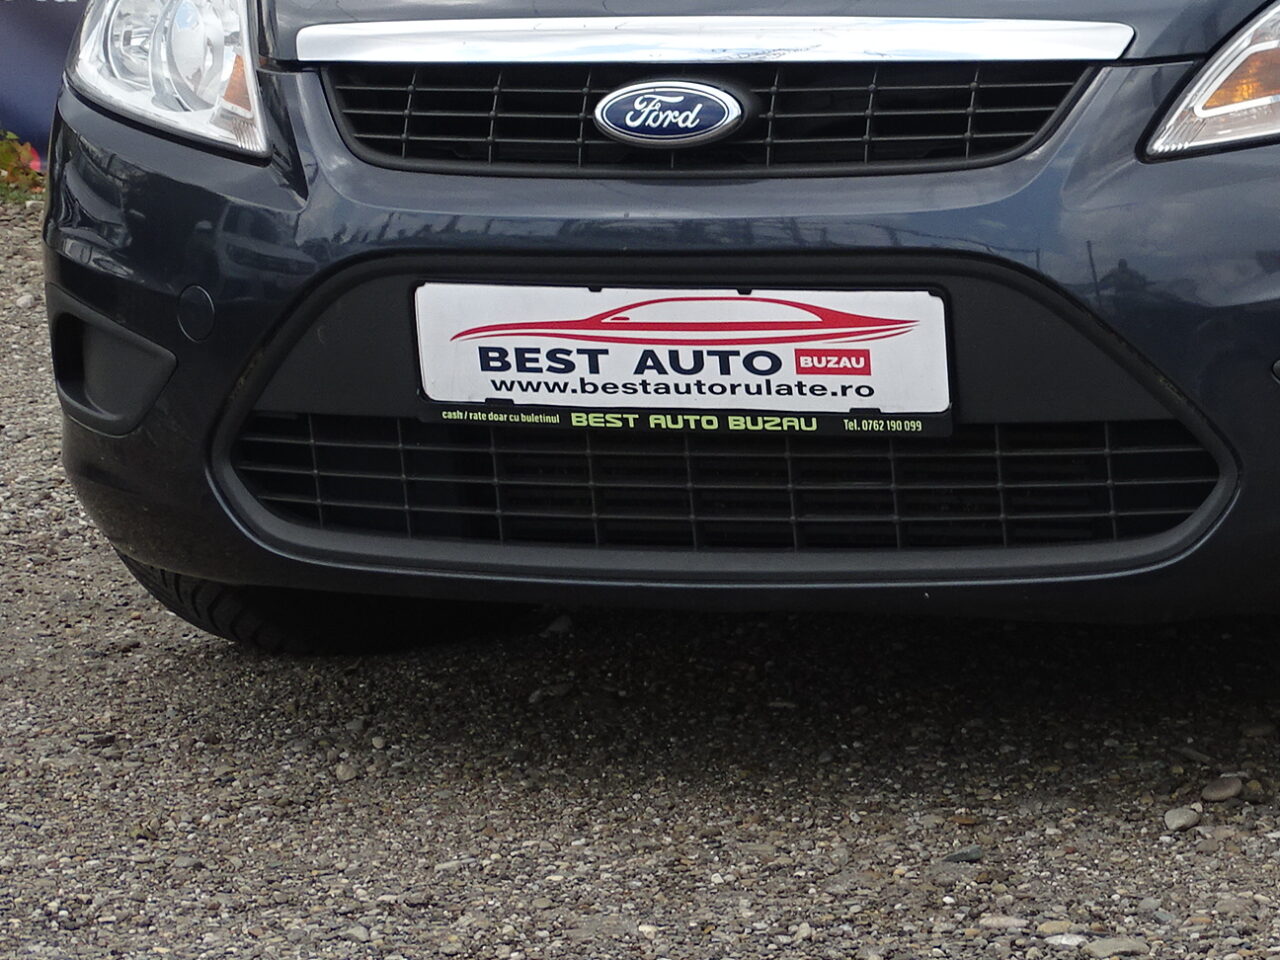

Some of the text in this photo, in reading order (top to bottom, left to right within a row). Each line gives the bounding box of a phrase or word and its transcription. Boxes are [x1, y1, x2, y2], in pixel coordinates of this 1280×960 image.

[625, 95, 702, 128] Ford
[478, 346, 866, 376] BEST AUTO BUZAU
[490, 377, 875, 398] www.bestautorulate.ro
[488, 412, 508, 423] doar
[509, 415, 520, 423] cu
[571, 413, 639, 428] BEST
[649, 415, 719, 430] AUTO
[728, 416, 818, 431] BUZAU
[843, 419, 861, 431] Tel.
[861, 420, 885, 431] 0762
[886, 420, 903, 432] 190
[903, 421, 922, 433] 099
